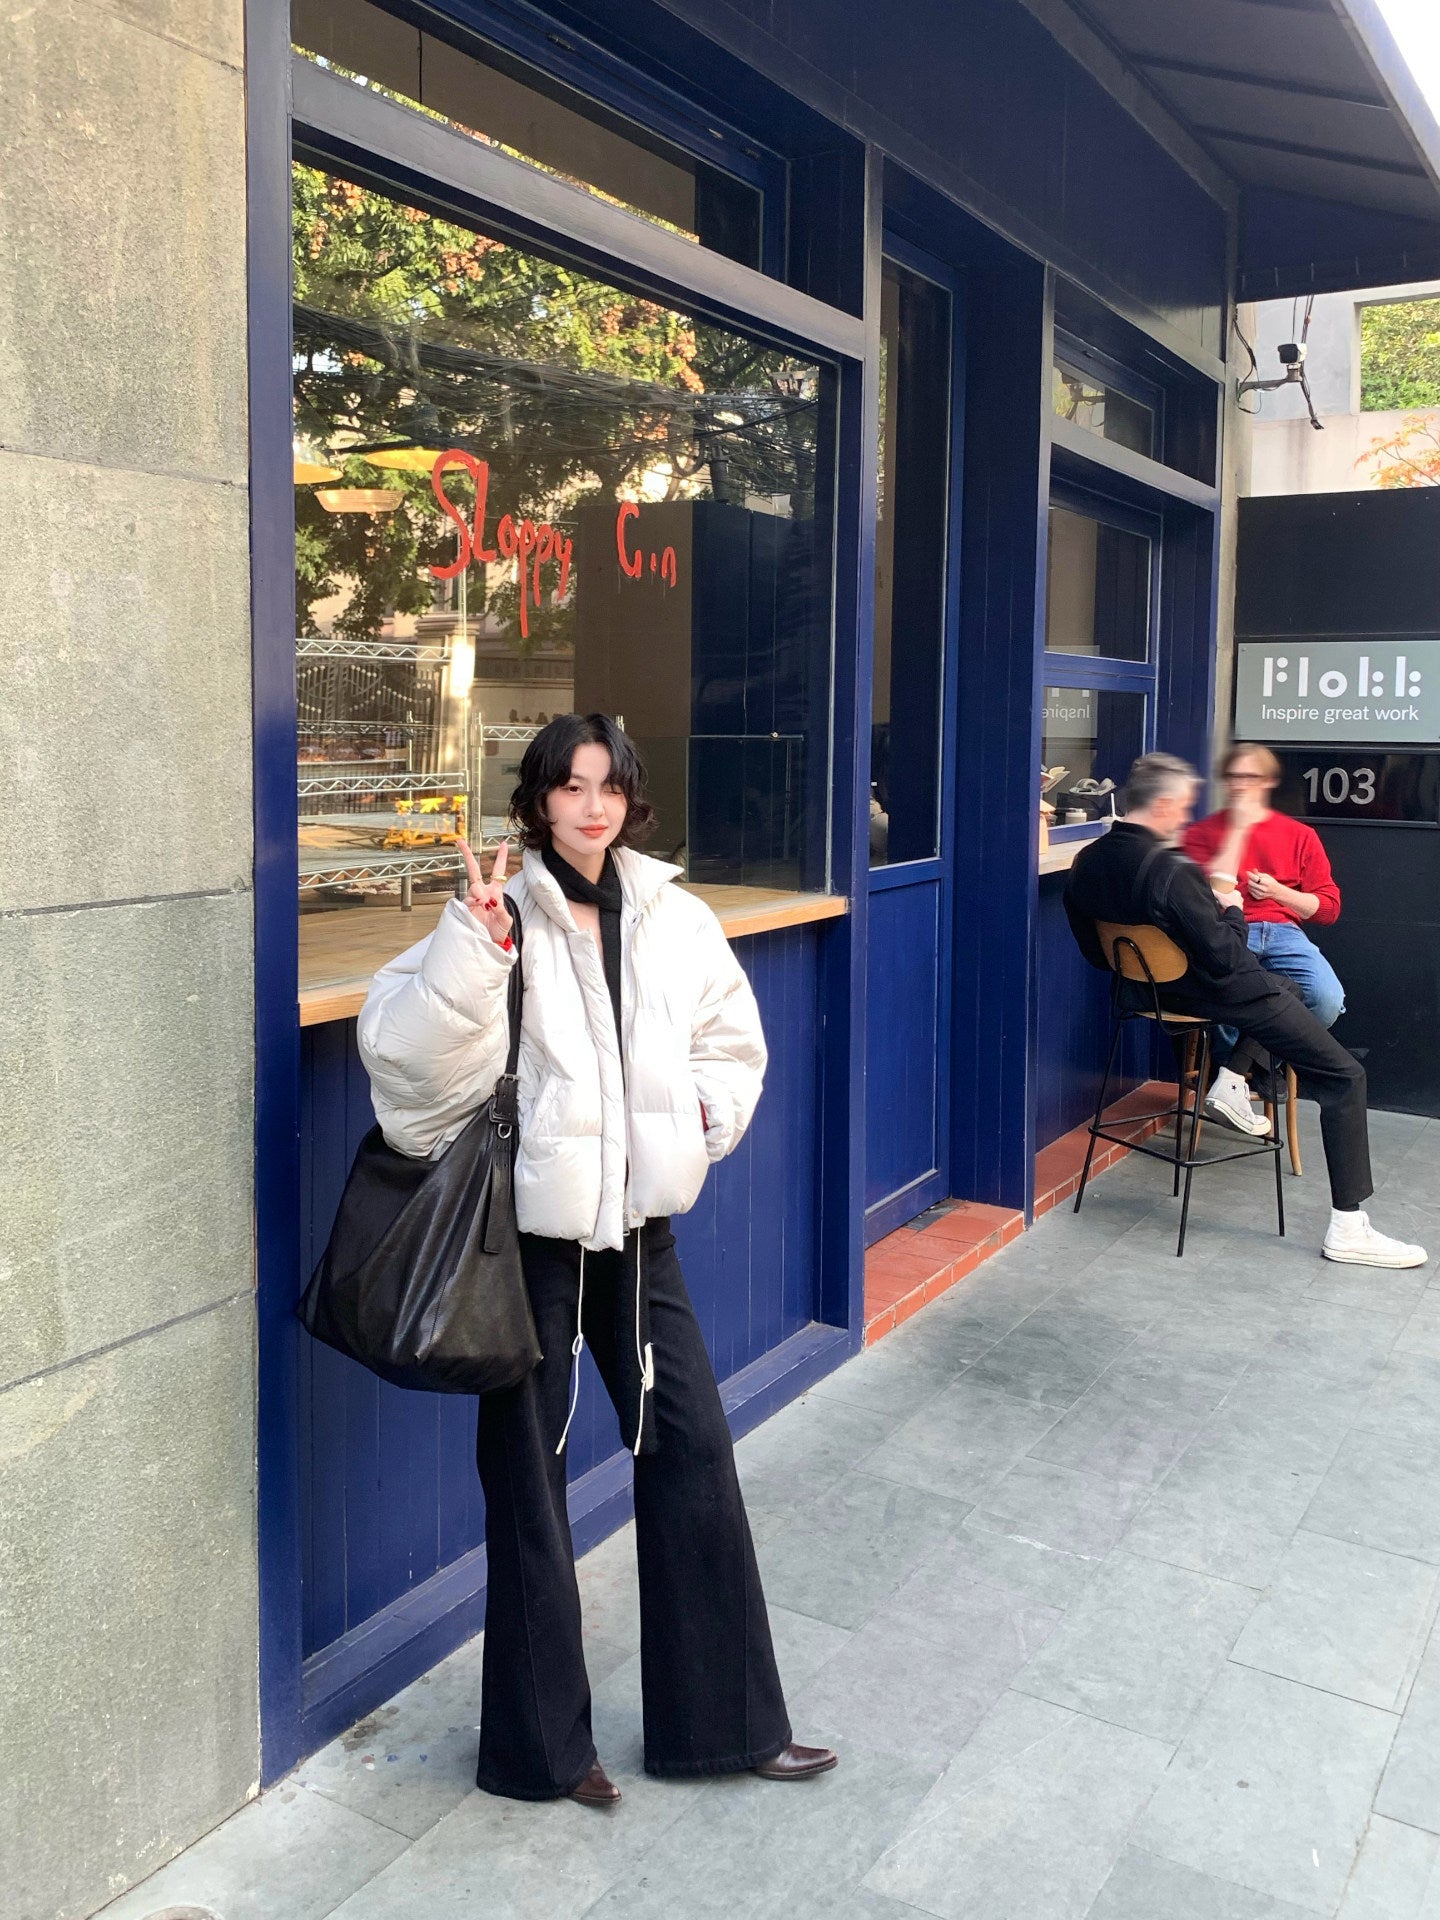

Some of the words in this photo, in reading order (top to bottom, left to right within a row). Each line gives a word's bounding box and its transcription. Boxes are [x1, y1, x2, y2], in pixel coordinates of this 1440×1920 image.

[616, 501, 677, 588] Gin
[1261, 704, 1319, 723] Inspire
[1324, 705, 1369, 724] great
[1375, 705, 1419, 721] work
[1302, 767, 1376, 805] 103
